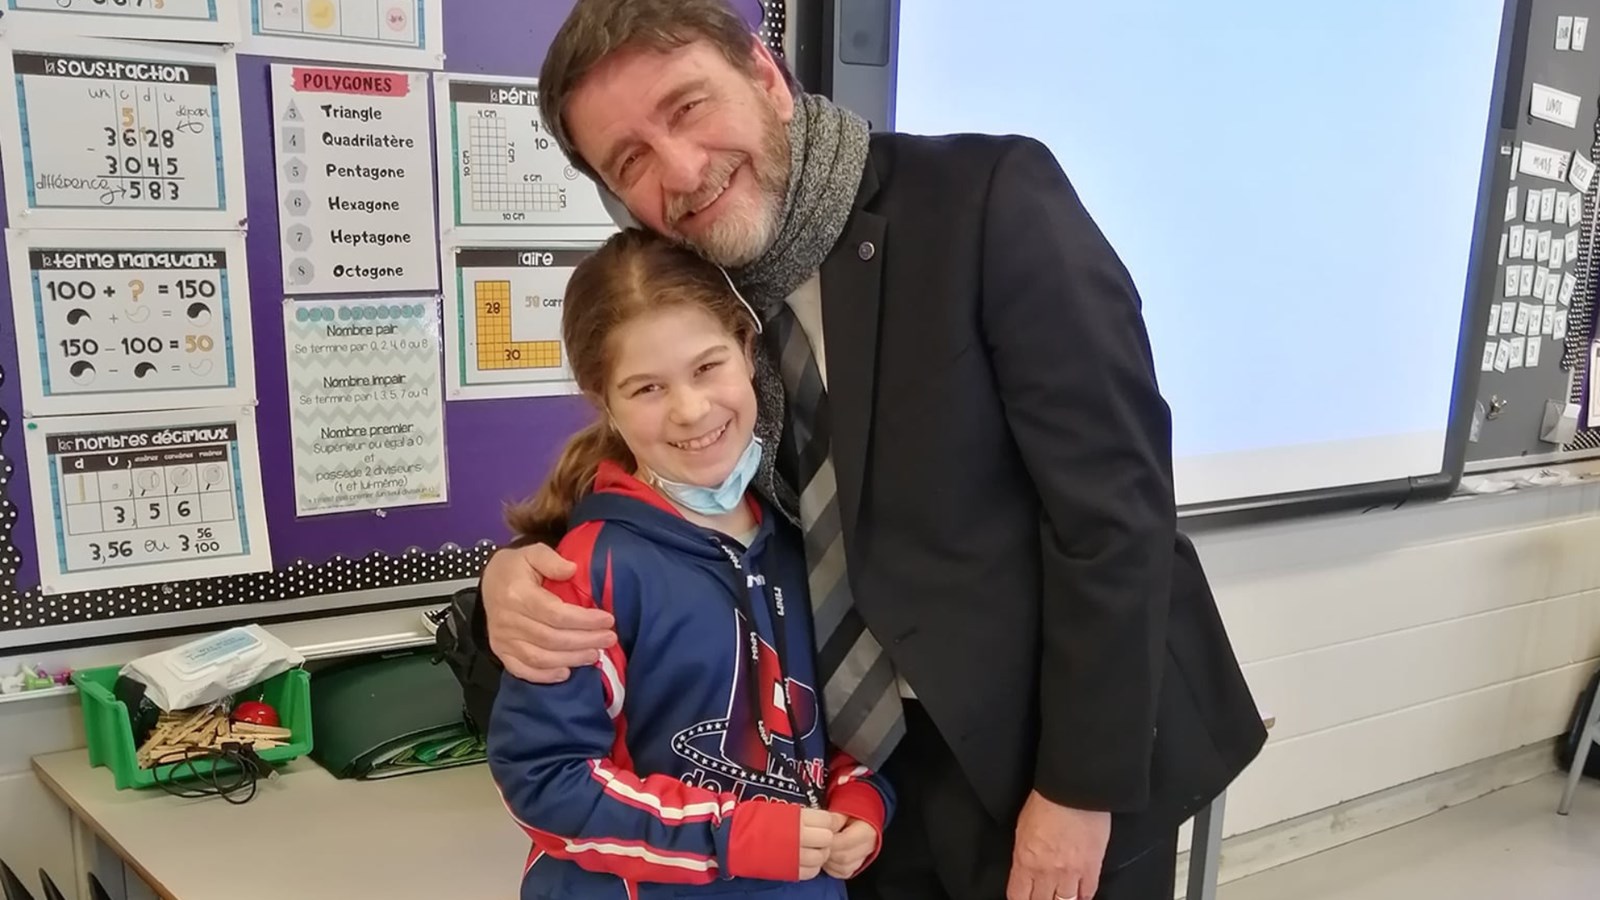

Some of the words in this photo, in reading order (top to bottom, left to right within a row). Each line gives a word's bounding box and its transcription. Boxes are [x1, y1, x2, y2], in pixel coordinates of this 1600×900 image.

[45, 59, 55, 74] la
[56, 59, 189, 82] soustraction
[303, 73, 393, 92] POLYGONES
[121, 107, 134, 127] 5
[289, 109, 297, 119] 3
[320, 104, 382, 122] Triangle
[289, 135, 297, 146] 4
[322, 131, 414, 149] Quadrilatère
[534, 138, 549, 150] 10
[292, 166, 300, 177] 5
[326, 163, 405, 180] Pentagone
[294, 197, 302, 208] 6
[328, 196, 400, 213] Hexagone
[296, 232, 303, 242] 7
[330, 229, 411, 246] Heptagone
[53, 253, 114, 268] terme
[118, 252, 217, 269] manquant
[333, 264, 404, 280] Octogone
[46, 280, 96, 301] 100
[175, 279, 215, 299] 150
[485, 302, 501, 314] 28
[327, 325, 373, 337] Nombre
[376, 324, 398, 336] pair
[59, 338, 99, 357] 150
[121, 336, 163, 355] 100
[184, 335, 214, 353] 50
[295, 344, 307, 354] Se
[310, 343, 348, 353] termine
[350, 344, 368, 353] par
[505, 349, 521, 361] 30
[324, 376, 370, 388] Nombre
[372, 374, 406, 388] impair
[299, 395, 313, 405] Se
[315, 394, 352, 404] termine
[354, 393, 372, 403] par
[75, 431, 148, 450] nombres
[151, 427, 228, 445] décimaux
[321, 426, 367, 439] Nombre
[369, 423, 414, 437] premier
[313, 441, 366, 454] Supérieur
[368, 441, 381, 449] ou
[364, 454, 375, 463] et
[365, 466, 371, 476] 2
[373, 463, 422, 475] diviseurs
[346, 481, 357, 491] et
[197, 527, 213, 538] 56
[89, 540, 133, 564] 3,56
[178, 534, 189, 551] 3
[194, 541, 220, 554] 100
